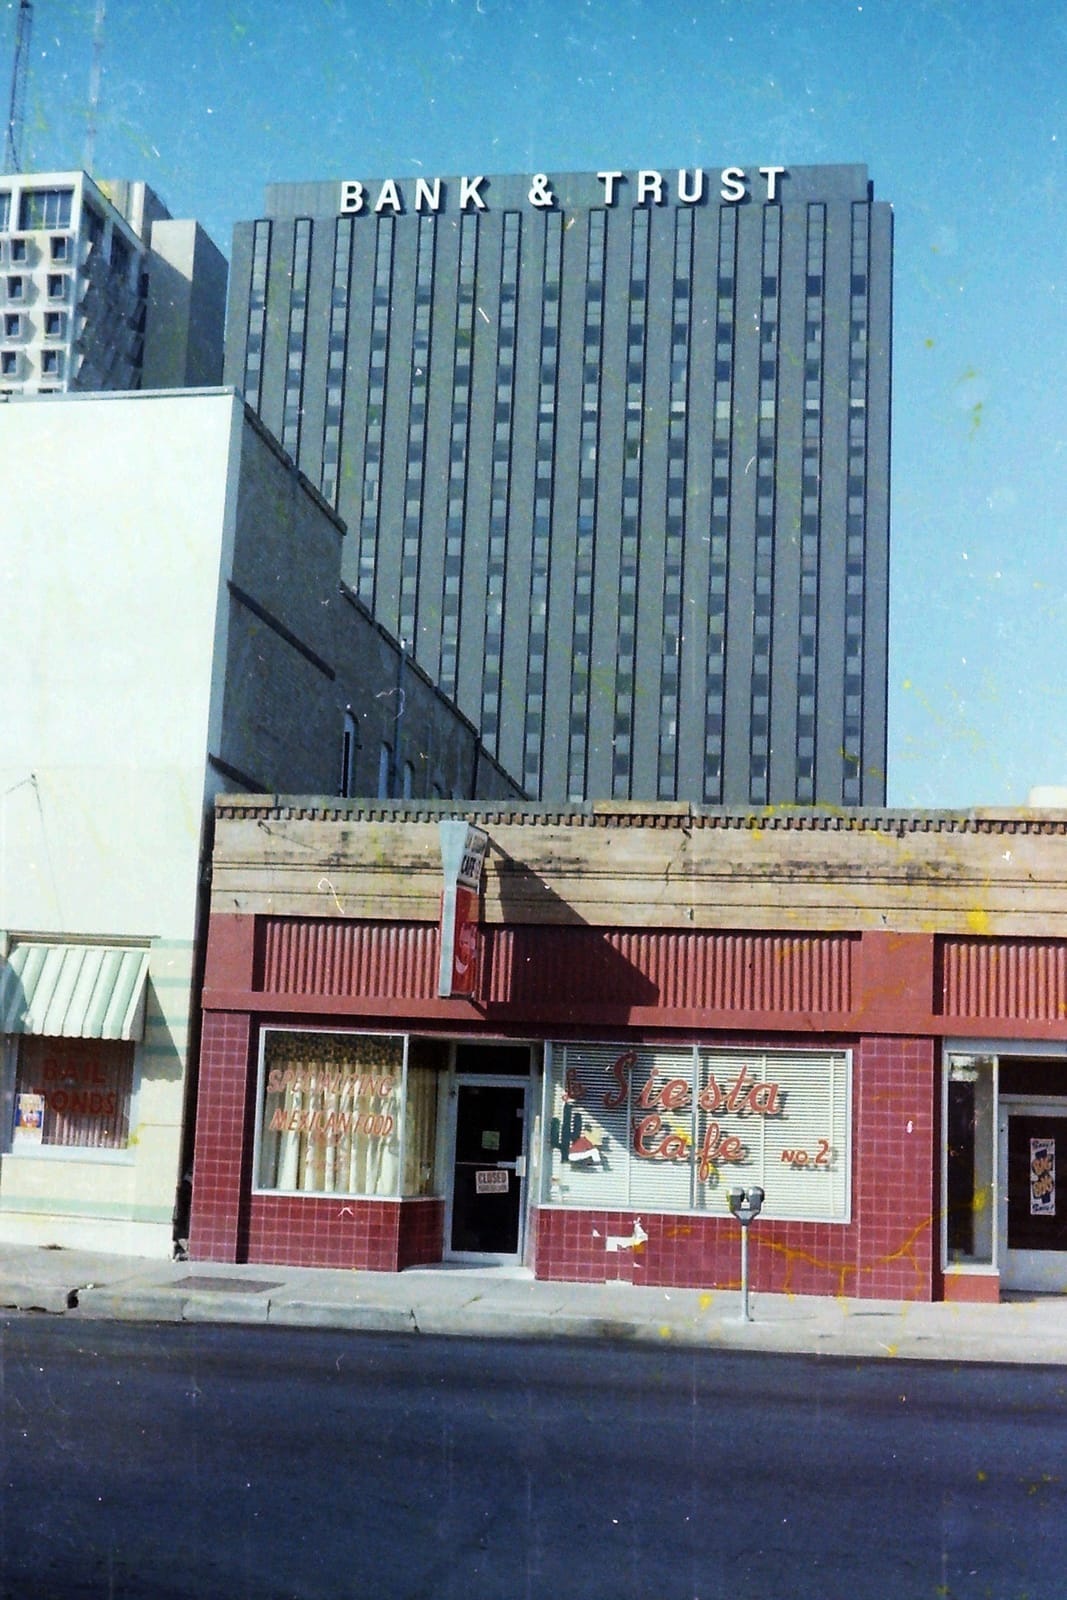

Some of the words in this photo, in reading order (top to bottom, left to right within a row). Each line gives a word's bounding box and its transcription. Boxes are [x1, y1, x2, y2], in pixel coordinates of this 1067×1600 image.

[340, 175, 486, 213] BANK
[528, 173, 553, 206] &
[597, 166, 785, 204] TRUST
[602, 1051, 780, 1115] Siesta
[33, 1088, 115, 1115] ONDS
[269, 1109, 350, 1134] MEXICAN
[355, 1113, 393, 1137] FOOD
[632, 1113, 744, 1182] Cafe
[815, 1138, 829, 1164] 2
[478, 1172, 507, 1184] CLOSED
